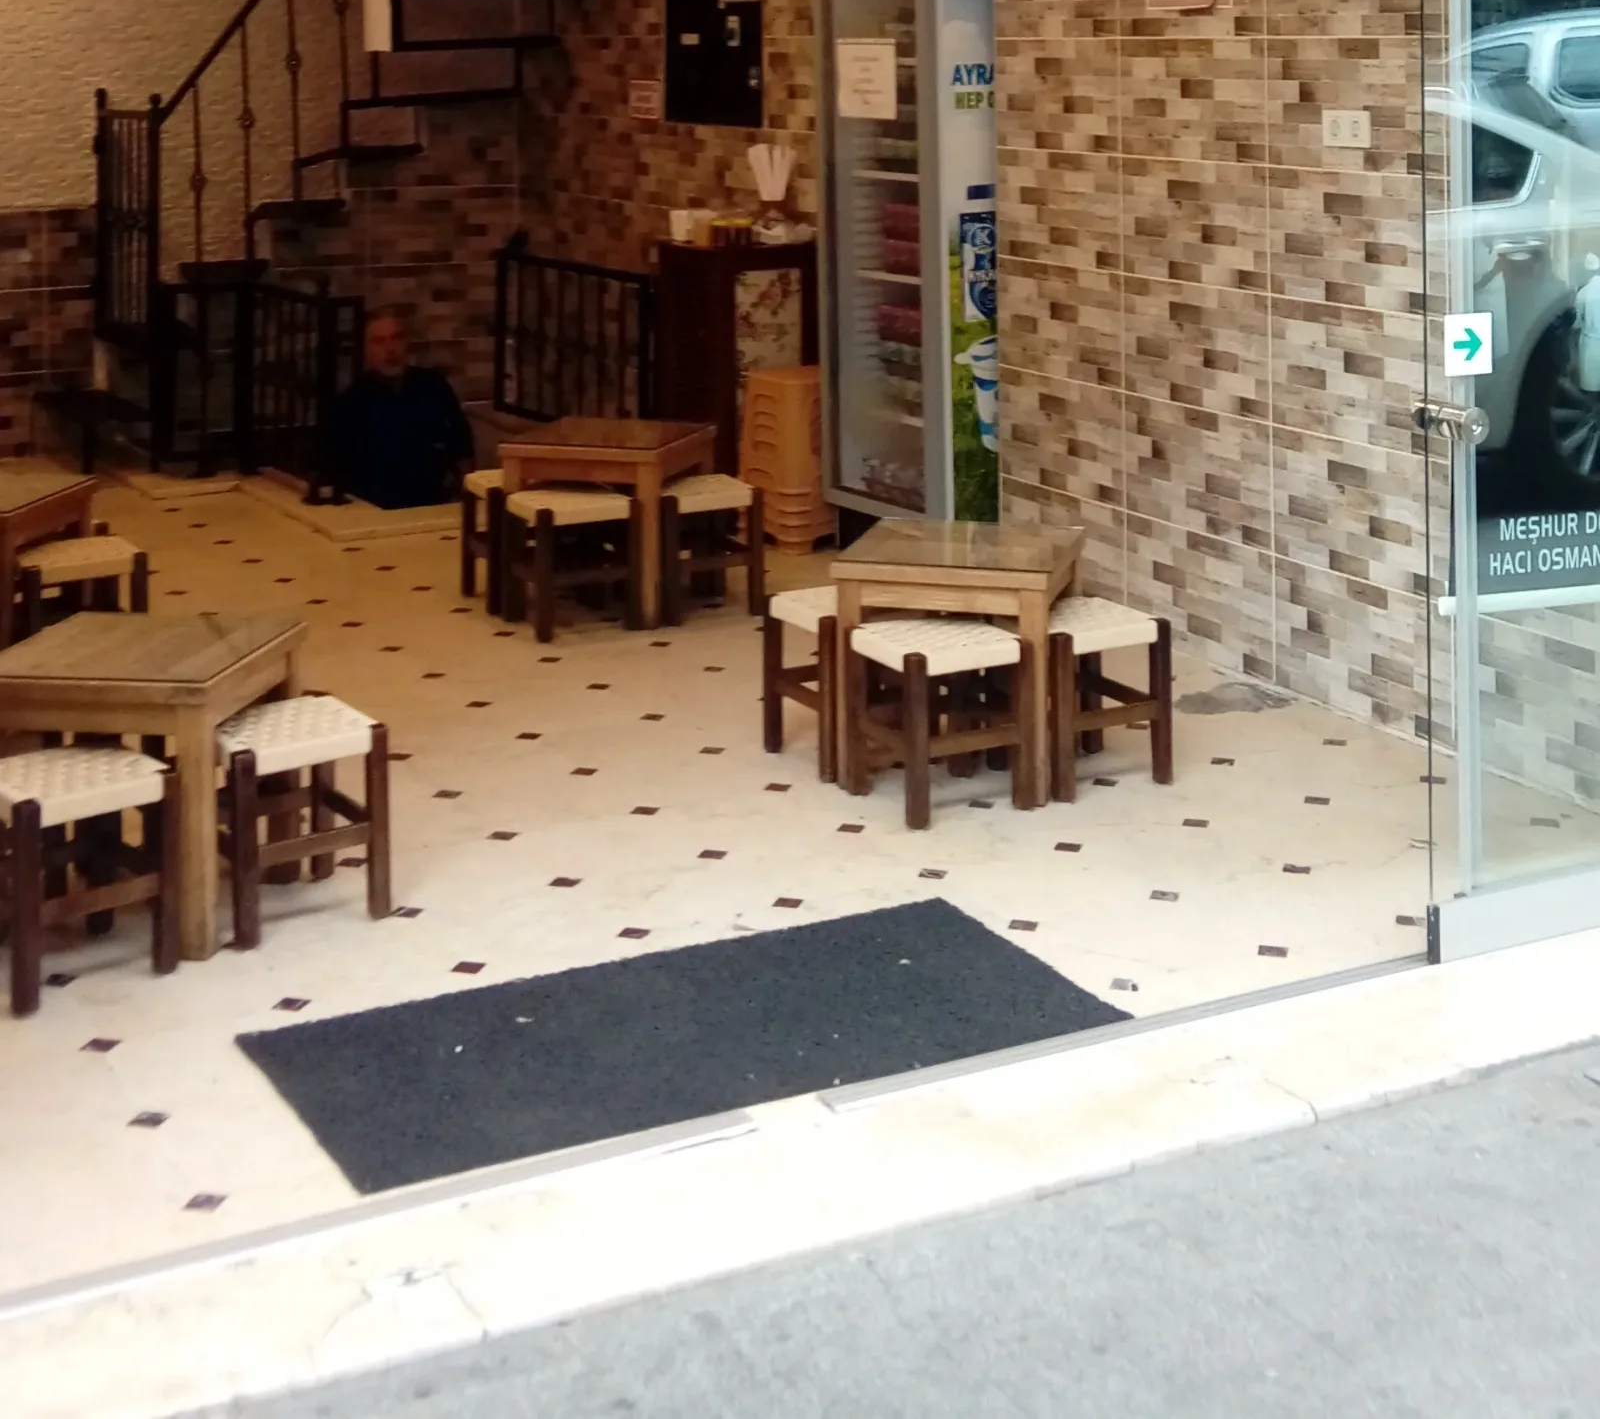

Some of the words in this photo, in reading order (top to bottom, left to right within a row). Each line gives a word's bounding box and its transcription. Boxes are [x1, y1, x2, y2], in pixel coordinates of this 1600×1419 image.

[1499, 512, 1578, 546] MEŞHUR
[1585, 511, 1600, 534] D
[1489, 549, 1532, 577] HACI
